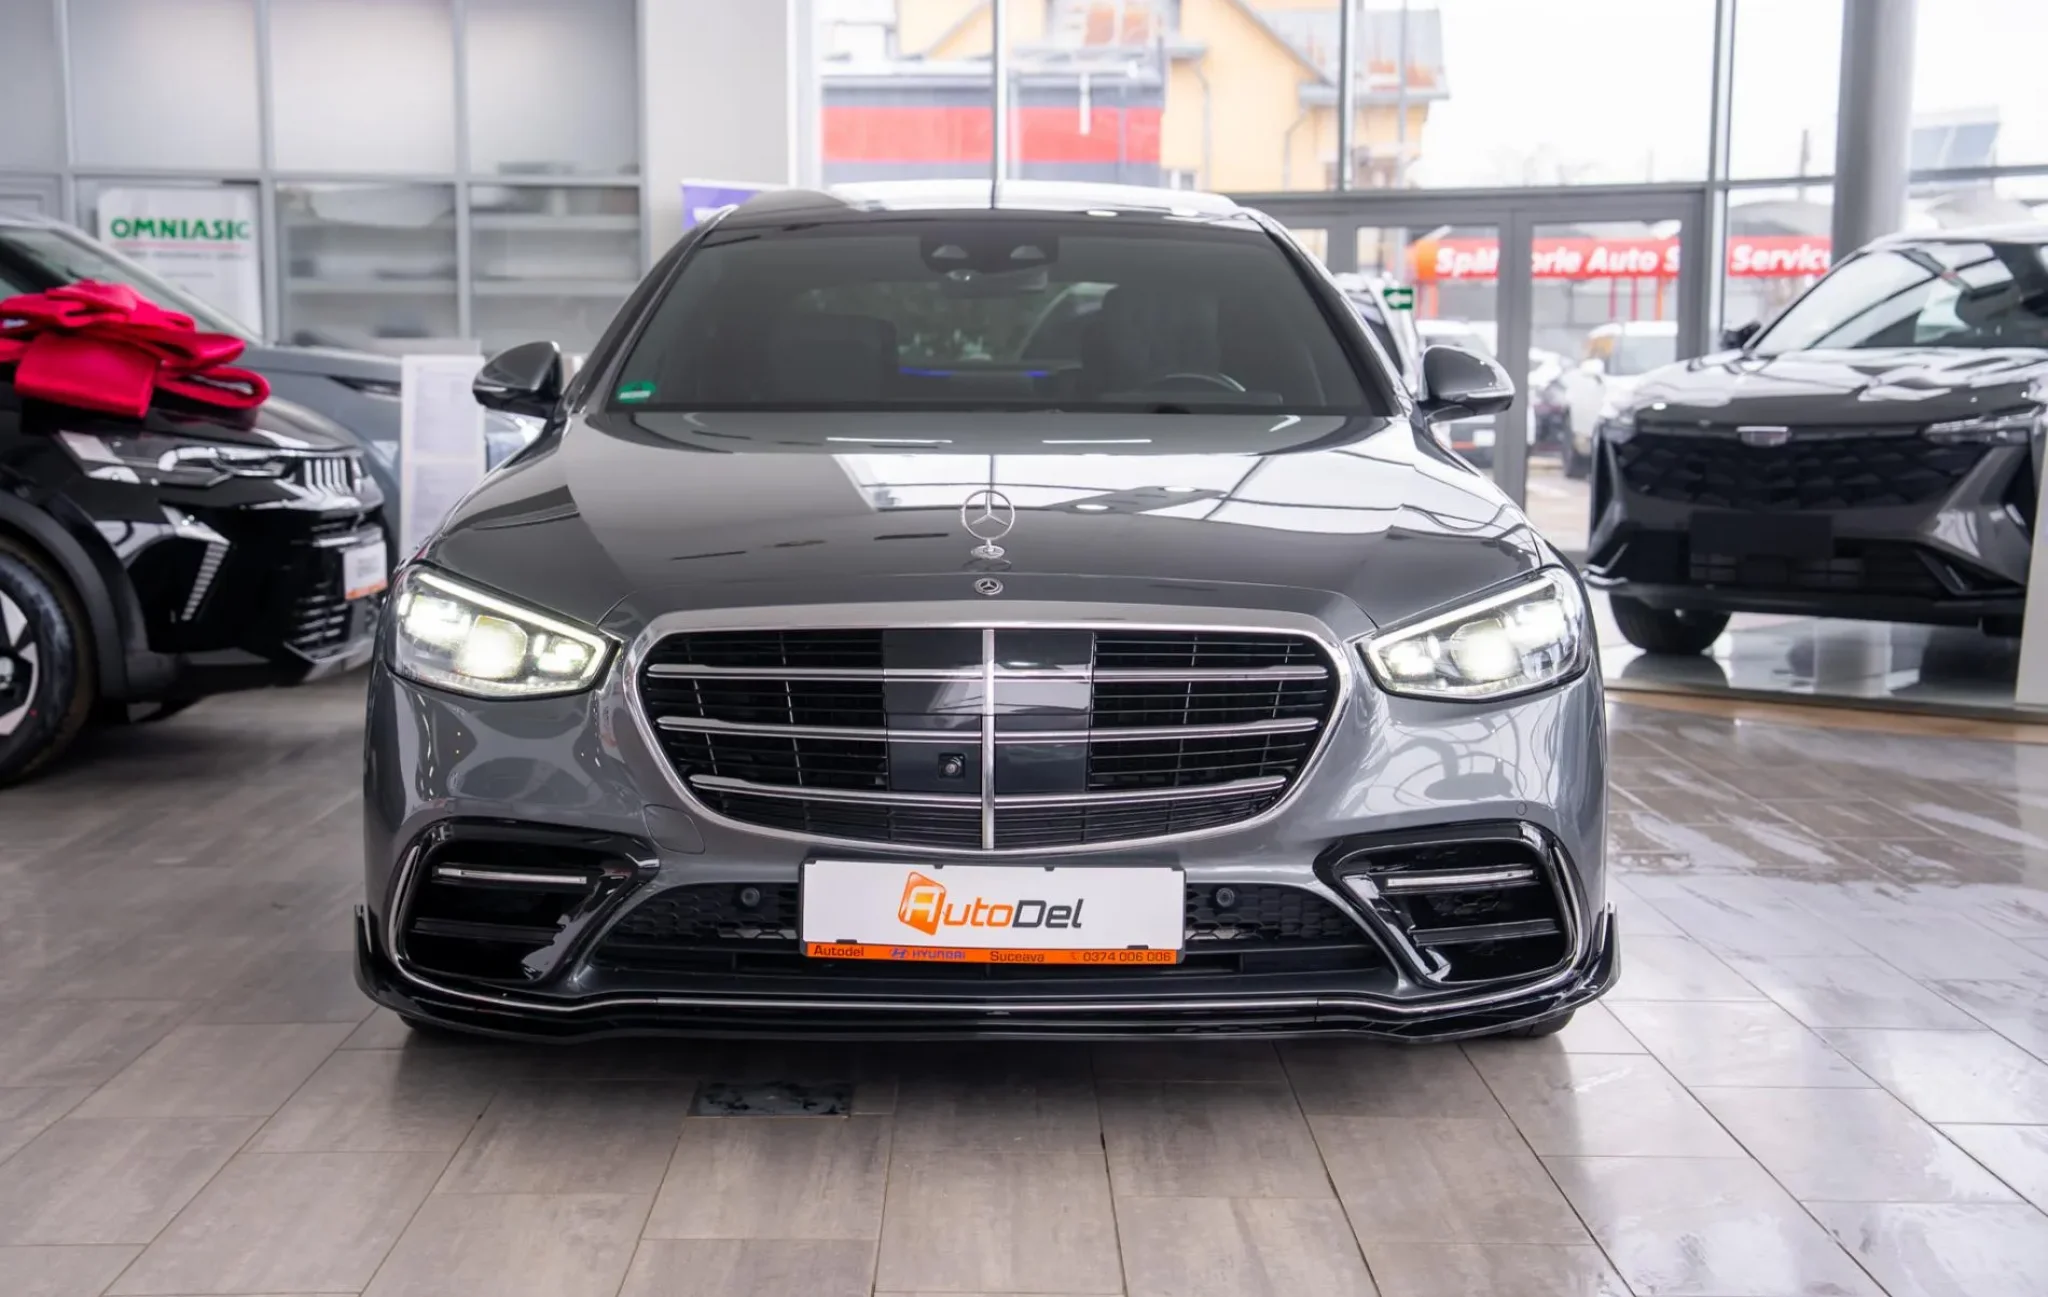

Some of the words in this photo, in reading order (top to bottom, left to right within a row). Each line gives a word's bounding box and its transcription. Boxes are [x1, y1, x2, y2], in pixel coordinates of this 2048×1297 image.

[1588, 247, 1658, 273] Auto
[899, 875, 1084, 932] AutoDel
[813, 944, 864, 957] Autodel
[912, 950, 966, 959] HYUNDAI
[990, 950, 1044, 963] Suceava
[1083, 952, 1116, 961] 0374
[1120, 952, 1143, 962] 006
[1147, 952, 1171, 962] 006
